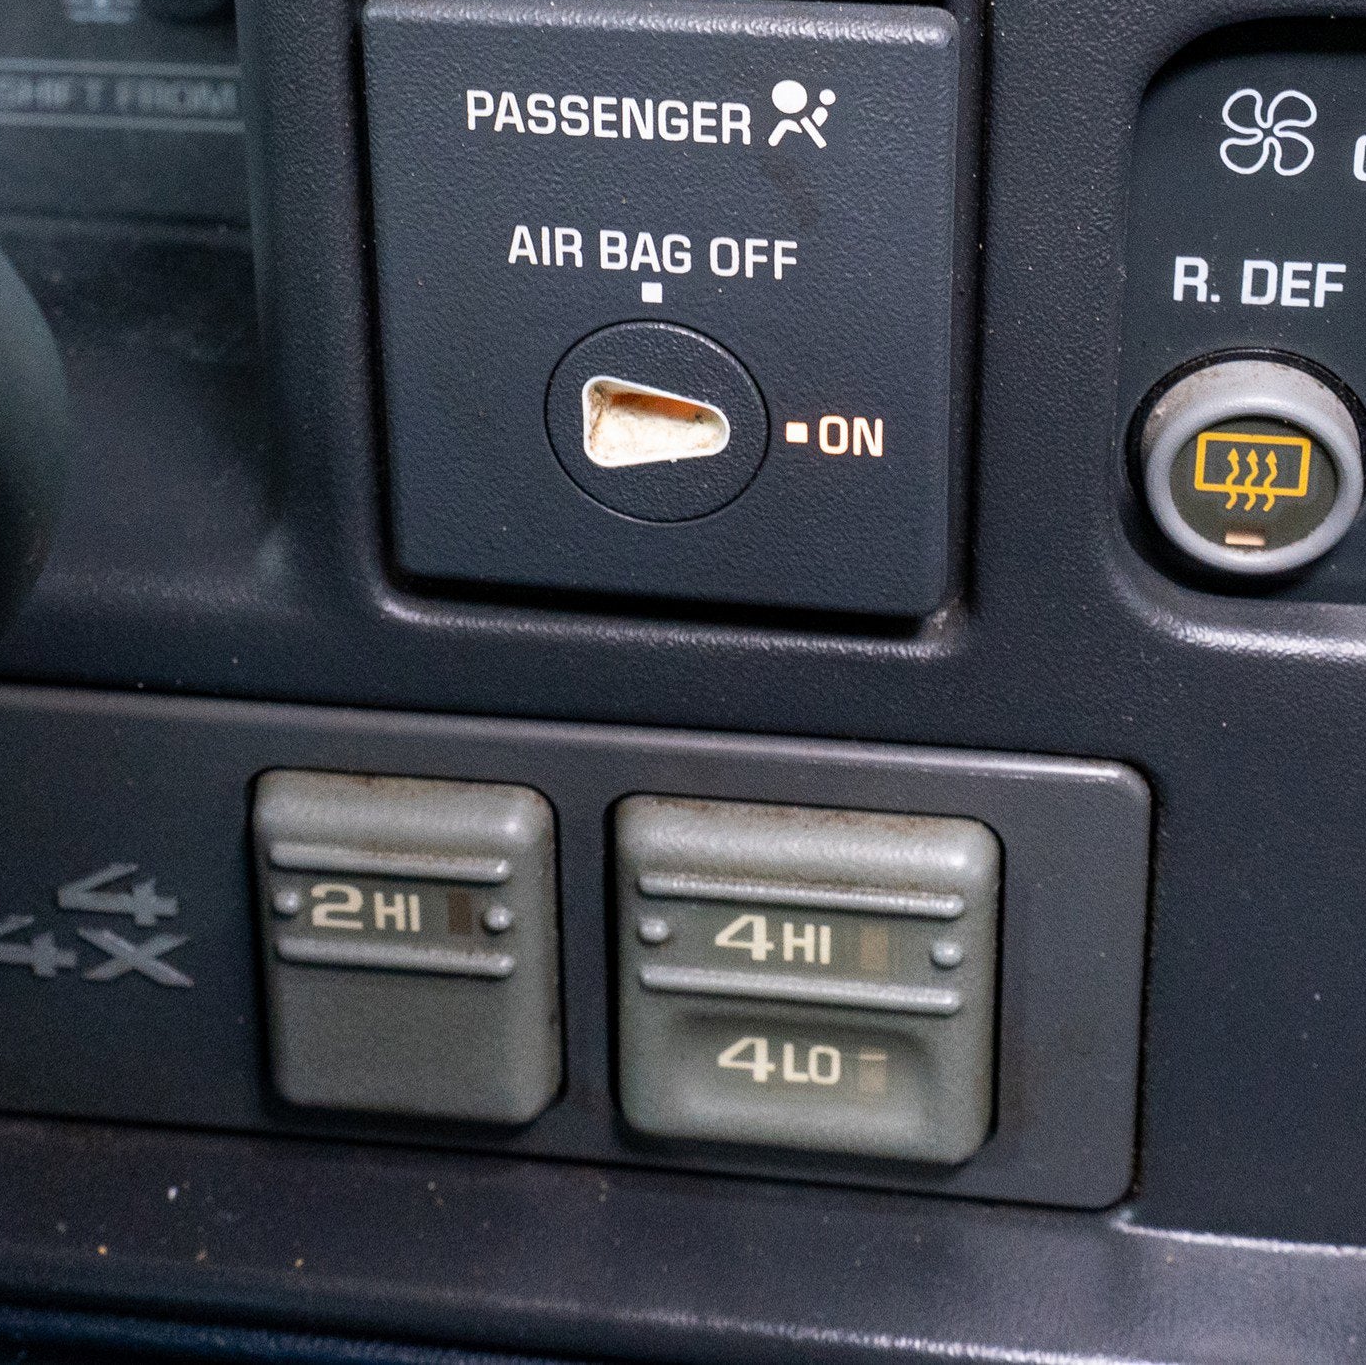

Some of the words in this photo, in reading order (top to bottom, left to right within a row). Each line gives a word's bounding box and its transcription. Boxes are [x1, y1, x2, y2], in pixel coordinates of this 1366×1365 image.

[465, 89, 753, 147] PASSENGER
[507, 225, 584, 269] AIR
[599, 230, 693, 275] BAG
[709, 236, 799, 282] OFF
[1172, 255, 1221, 304] R.
[1239, 257, 1348, 309] DEF
[818, 414, 885, 458] ON
